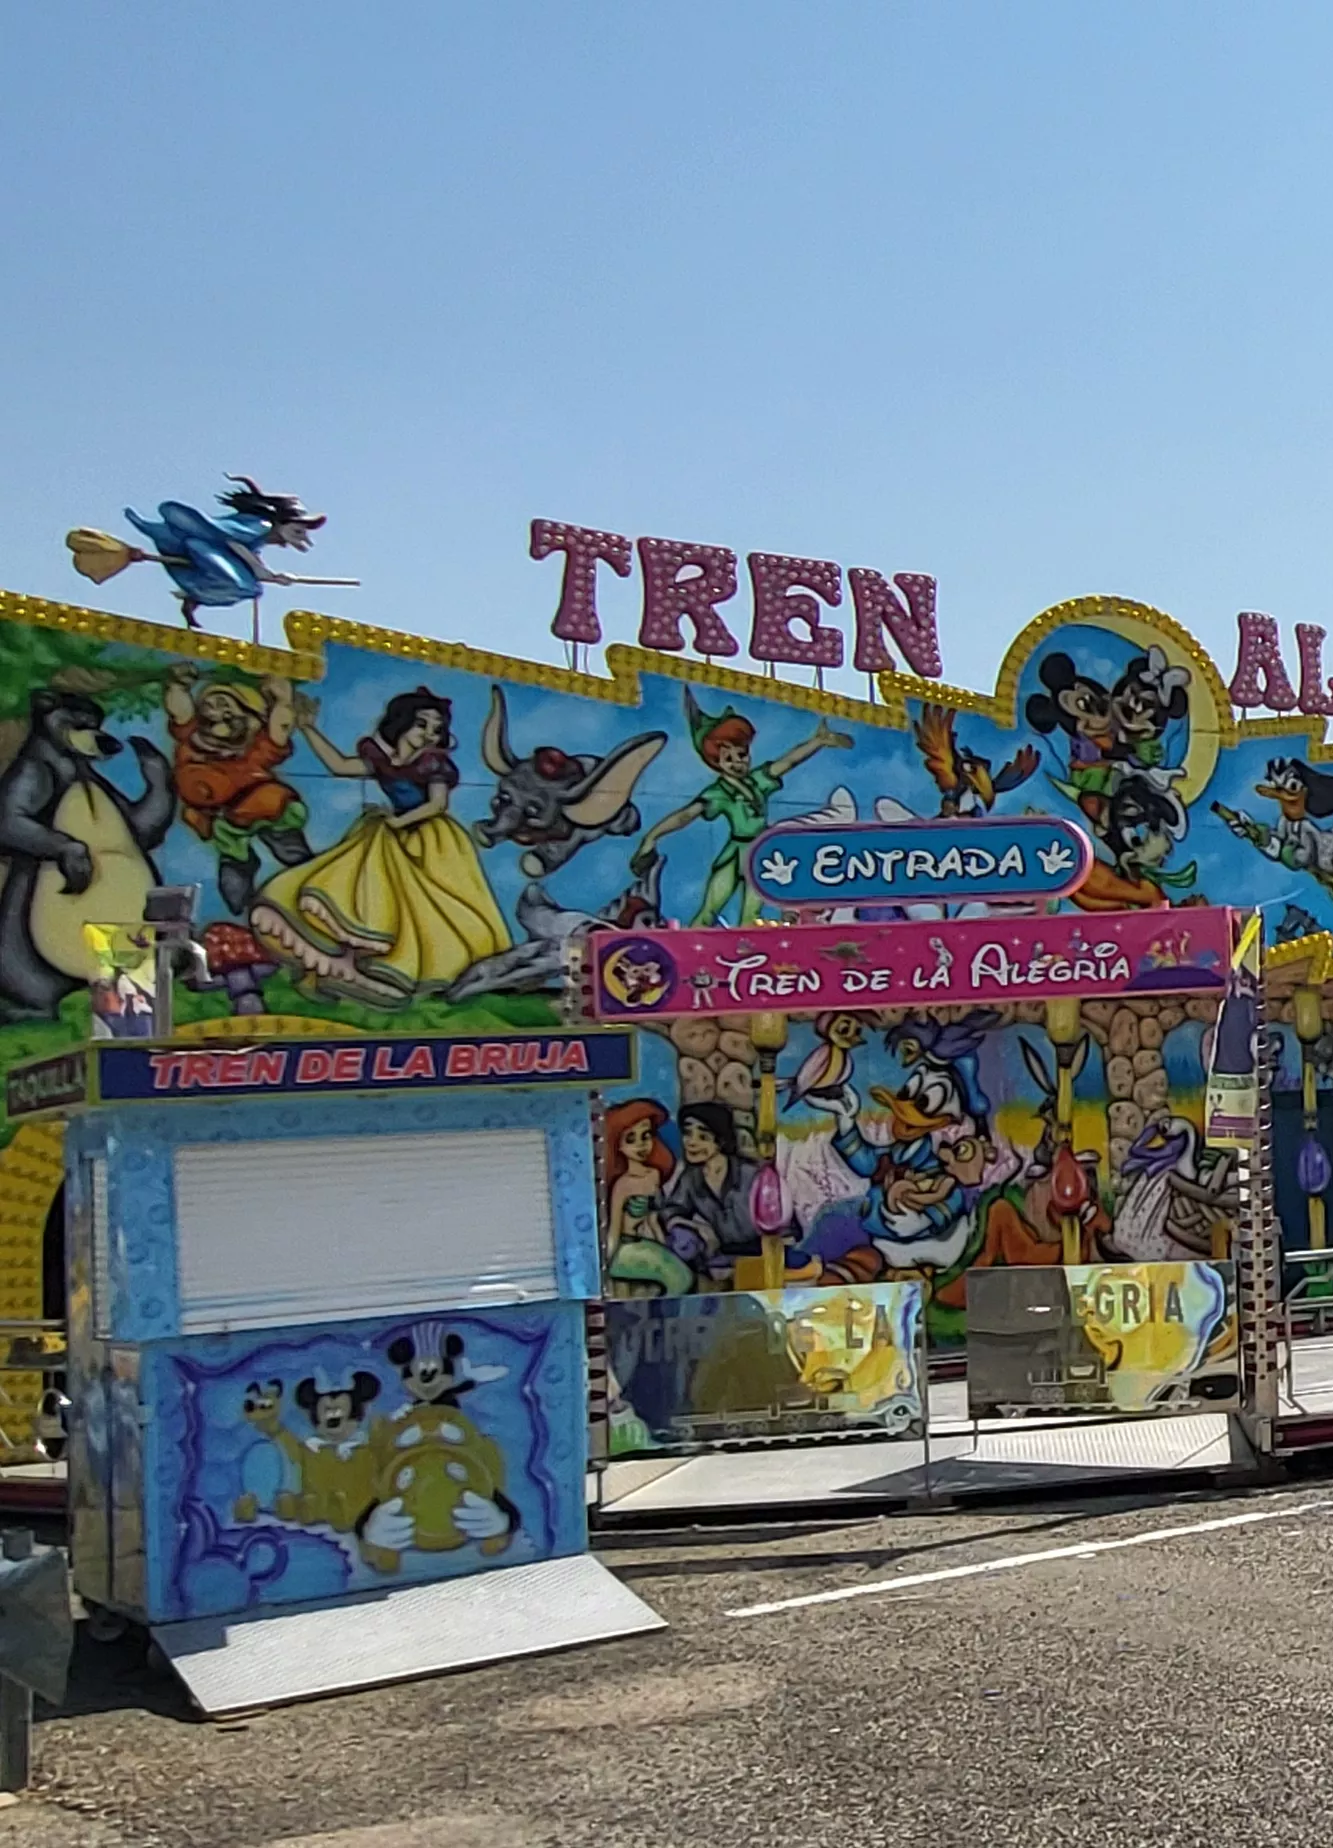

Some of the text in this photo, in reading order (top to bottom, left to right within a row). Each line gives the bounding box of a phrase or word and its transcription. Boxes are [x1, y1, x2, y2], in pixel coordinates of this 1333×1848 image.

[530, 518, 942, 678] TREN
[812, 844, 1024, 884] ENTRADA
[716, 953, 821, 1001] TREN
[841, 969, 893, 992] DE
[912, 964, 952, 990] LA
[150, 1041, 588, 1089] TREN DE LA BRUJA
[844, 1299, 892, 1350] LA
